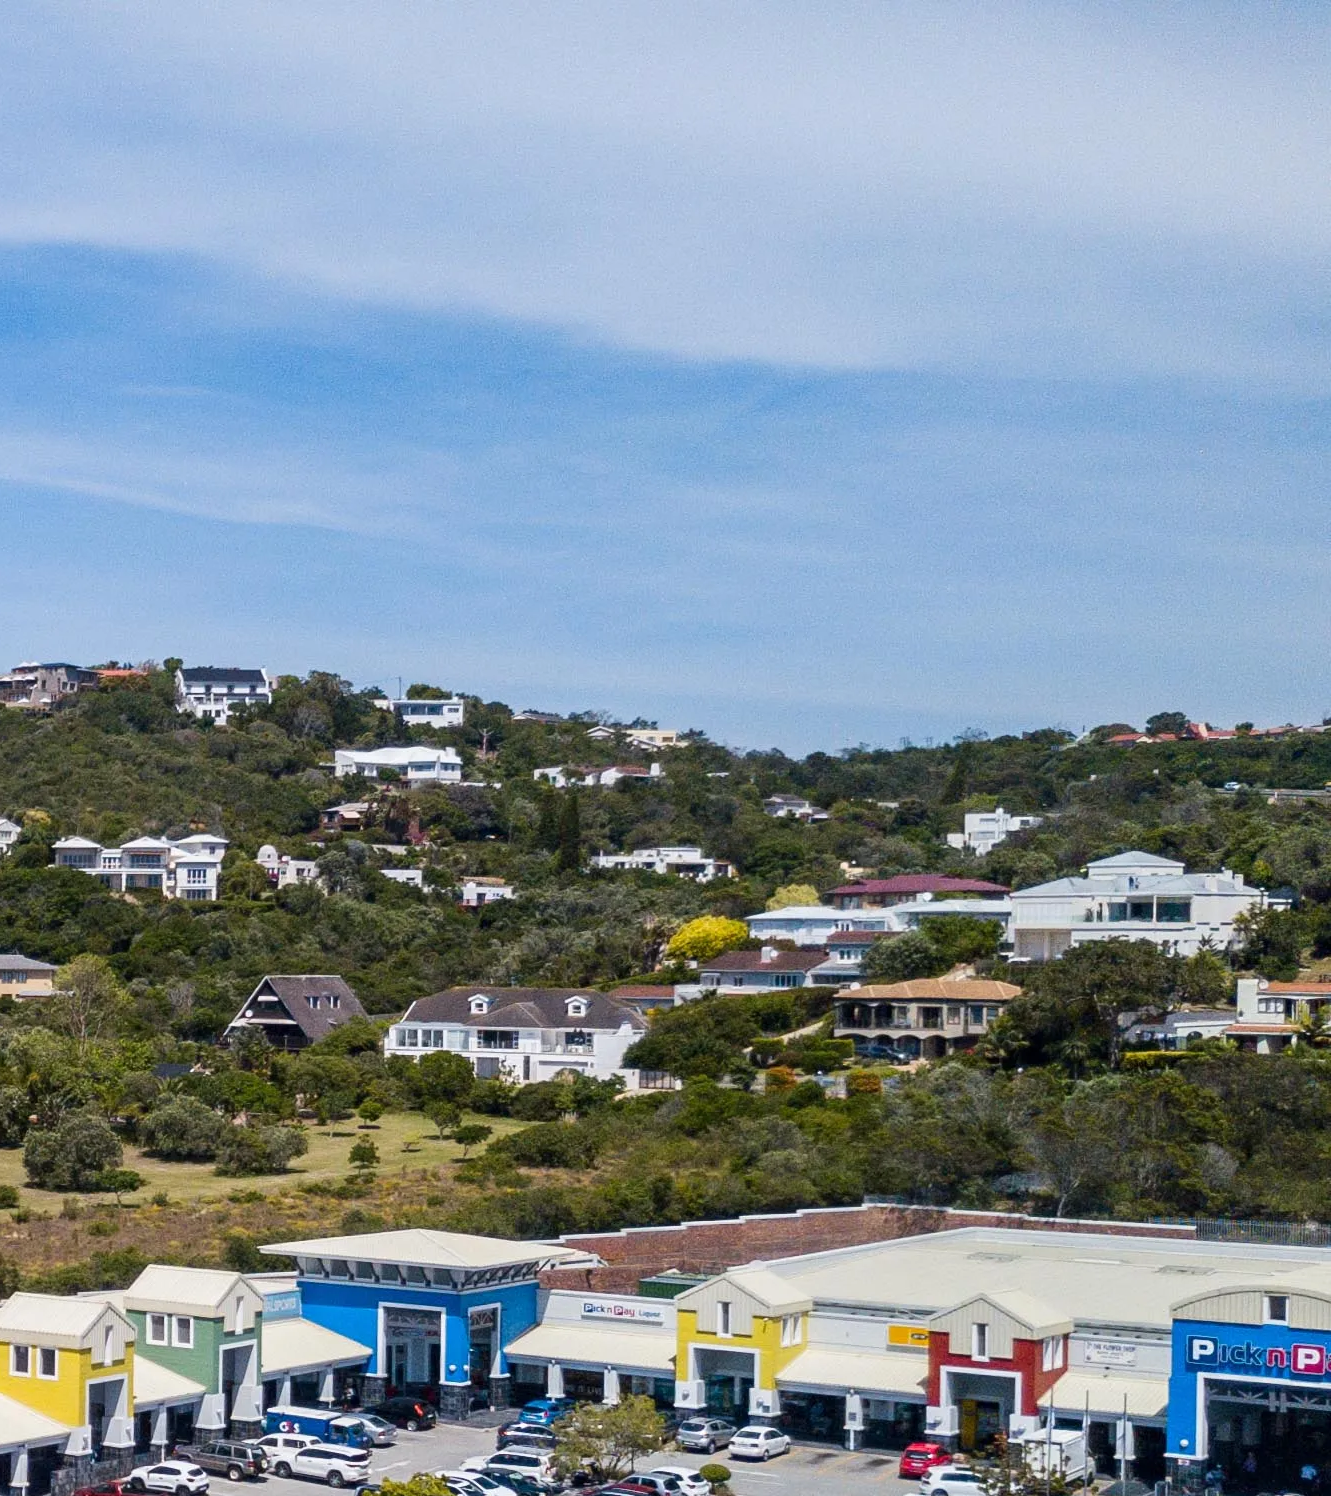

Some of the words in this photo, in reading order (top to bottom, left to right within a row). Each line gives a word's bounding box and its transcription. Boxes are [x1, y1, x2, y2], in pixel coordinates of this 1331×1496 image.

[584, 1303, 604, 1313] Pick
[614, 1305, 635, 1317] Pay
[1187, 1335, 1262, 1365] Pick
[1267, 1348, 1286, 1367] n
